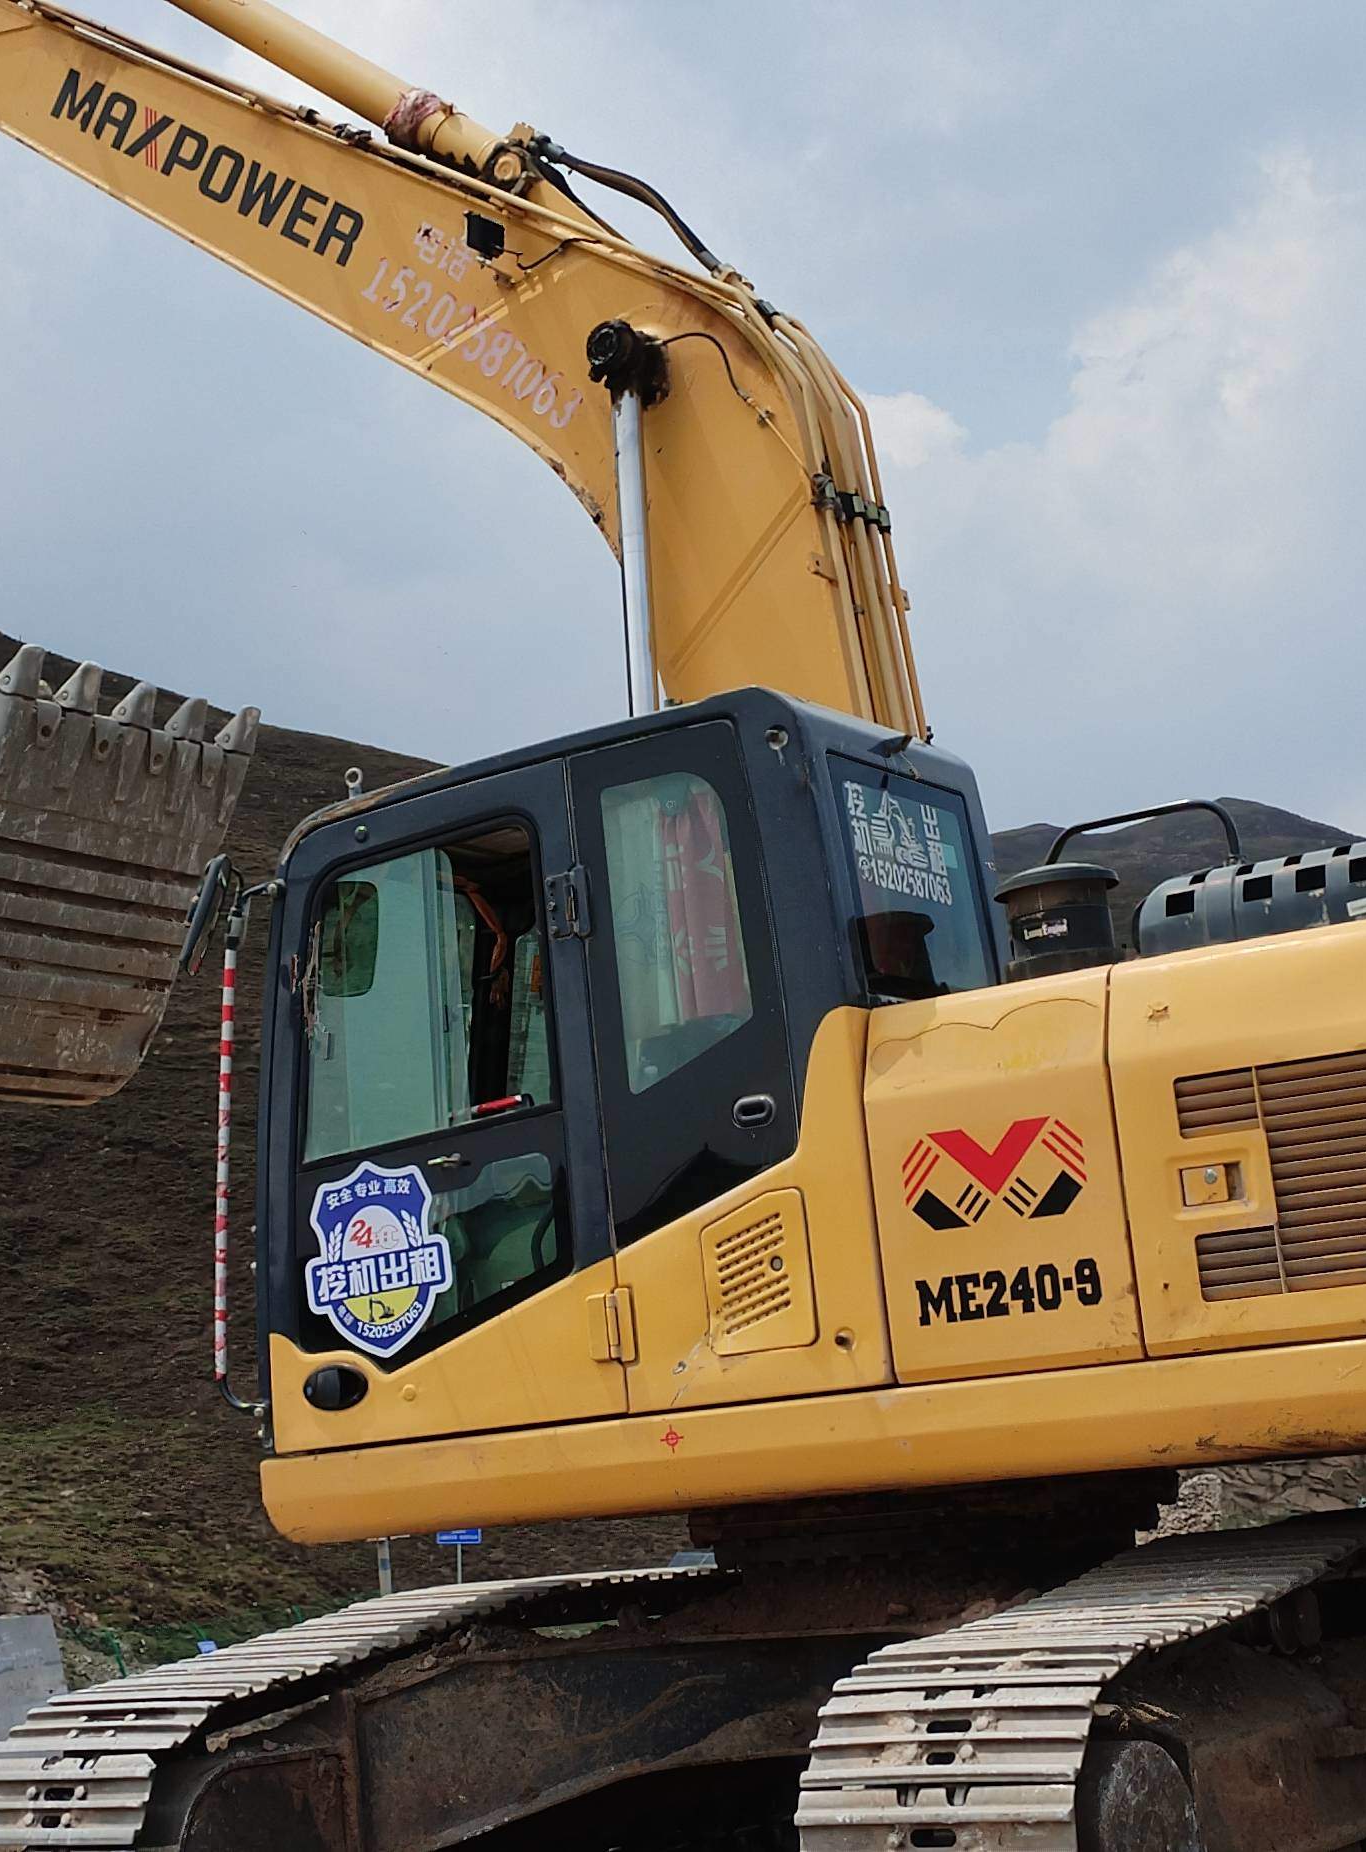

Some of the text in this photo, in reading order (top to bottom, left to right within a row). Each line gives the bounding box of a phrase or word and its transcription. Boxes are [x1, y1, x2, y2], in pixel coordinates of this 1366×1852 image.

[50, 68, 364, 267] MAXPOWER
[361, 256, 584, 429] 15202587063
[871, 857, 953, 906] 15202587063
[326, 1177, 411, 1211] 安全 专业 高效
[316, 1246, 442, 1303] 挖机出租
[915, 1257, 1103, 1326] ME240-9
[356, 1301, 423, 1338] 15202587063
